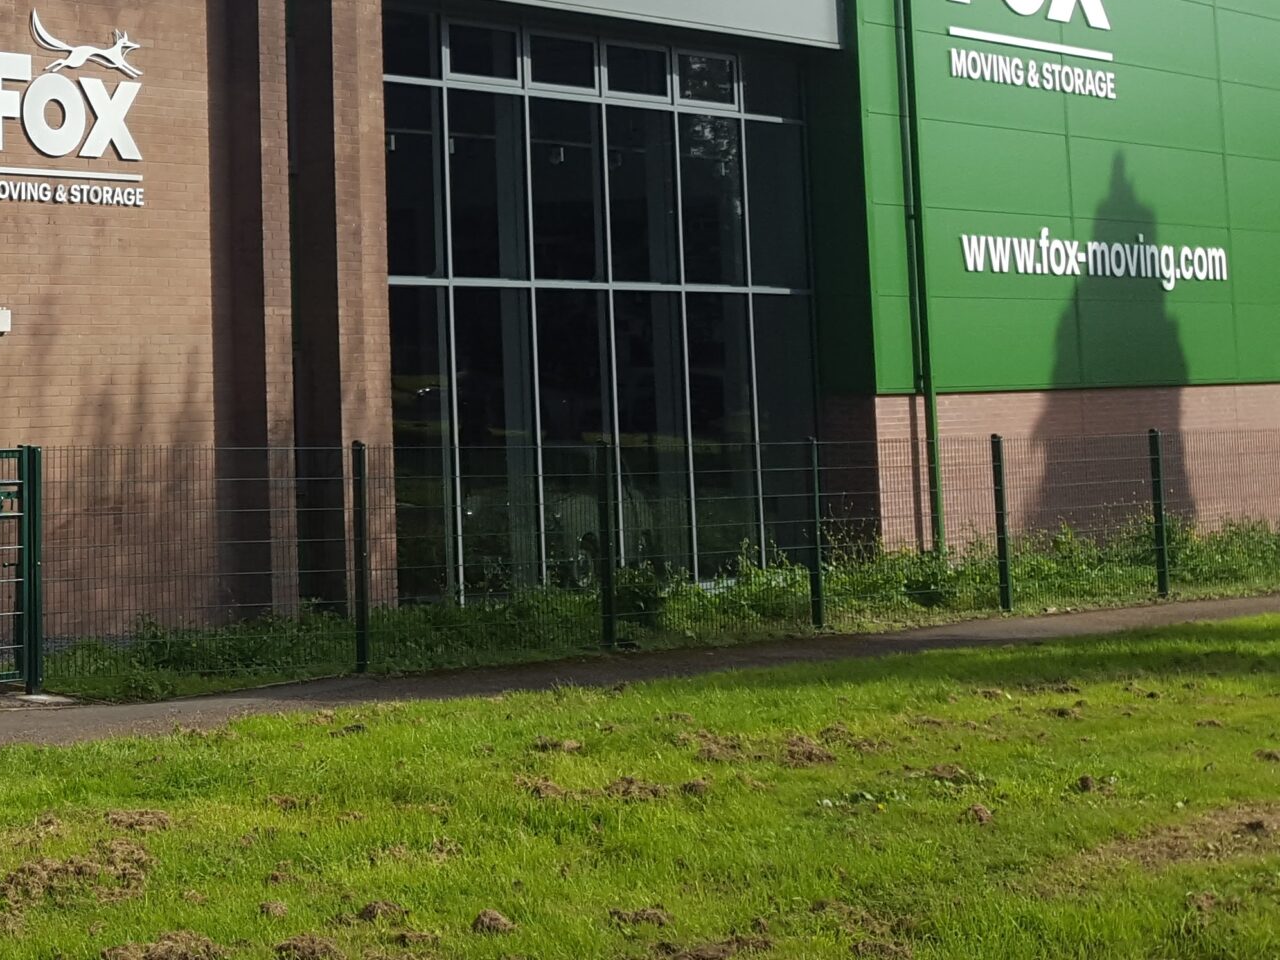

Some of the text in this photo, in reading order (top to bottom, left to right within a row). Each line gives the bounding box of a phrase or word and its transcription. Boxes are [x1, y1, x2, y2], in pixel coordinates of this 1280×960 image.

[950, 47, 1117, 99] MOVING & STORAGE
[55, 184, 67, 203] &
[70, 186, 145, 206] STORAGE
[961, 227, 1229, 290] www.fox-moving.com
